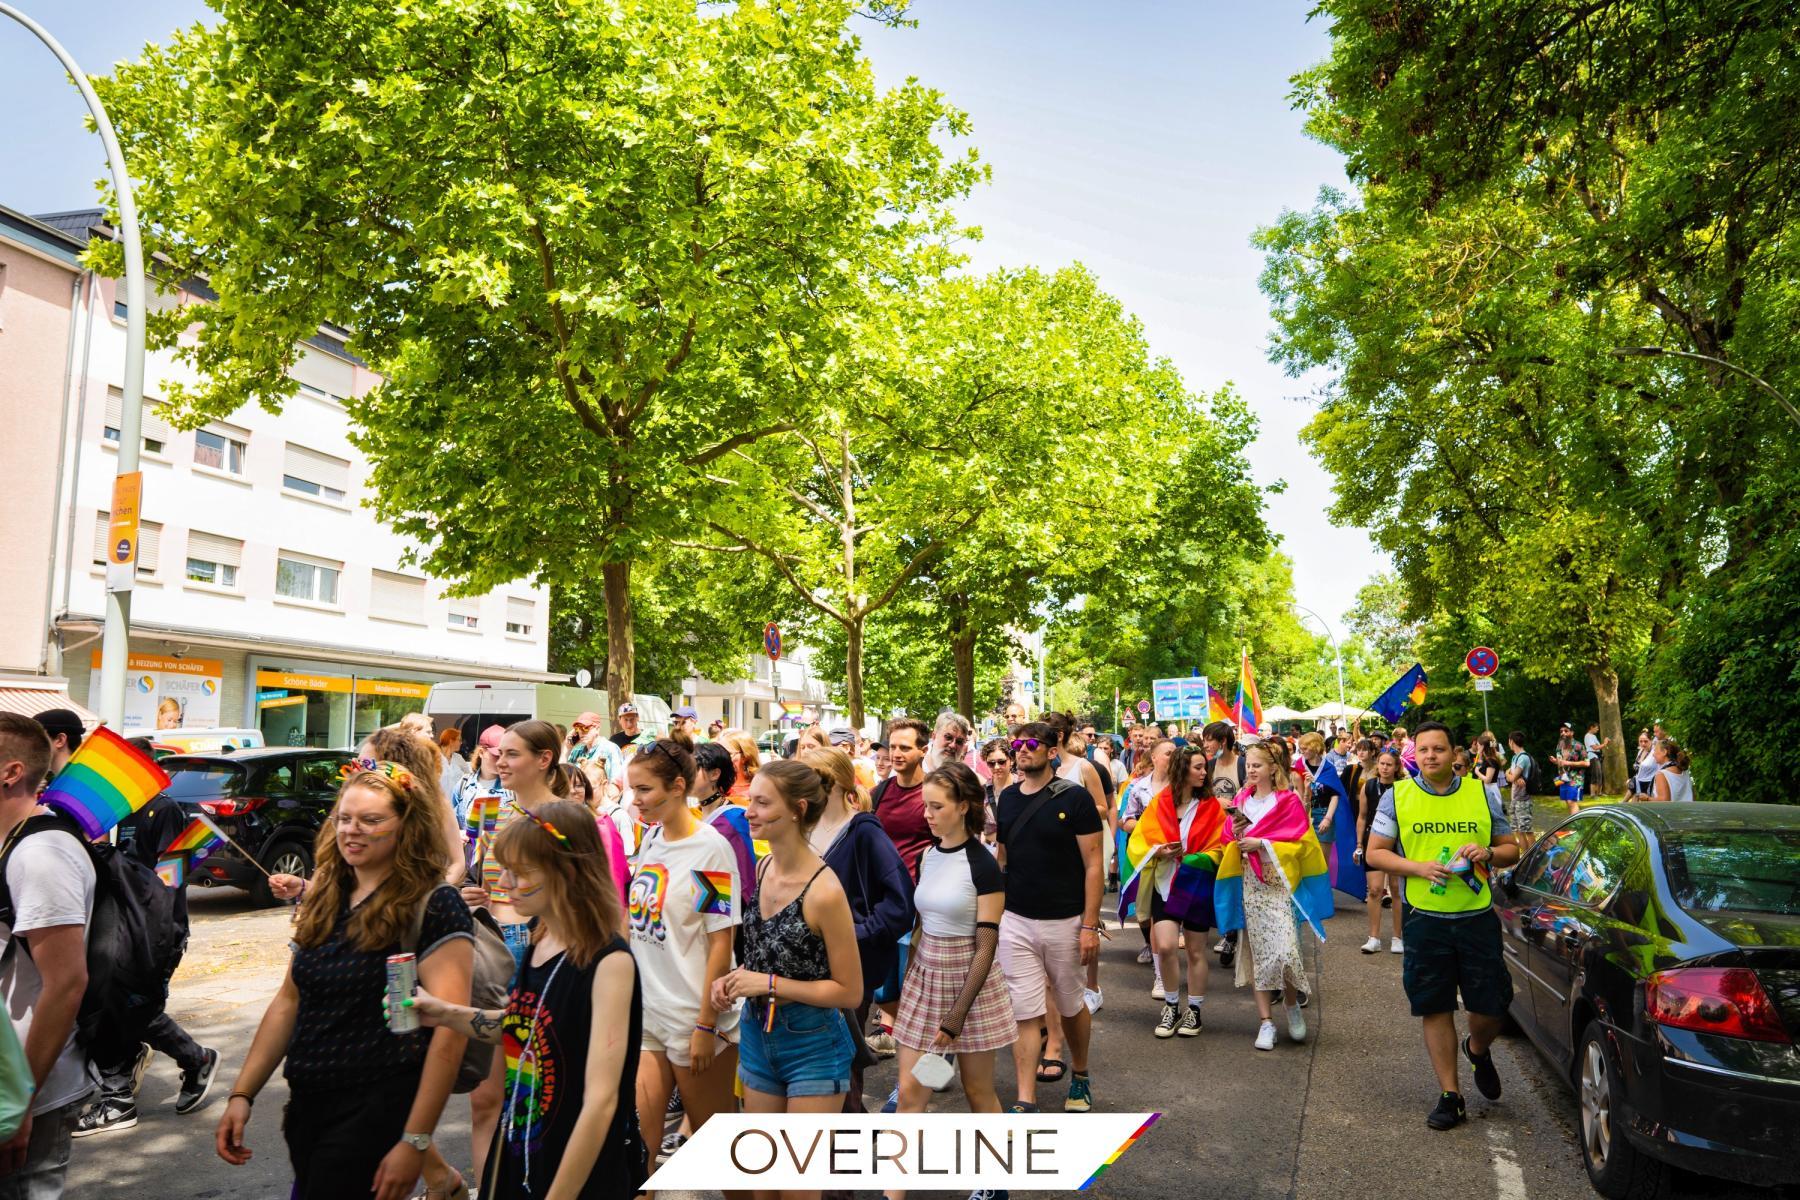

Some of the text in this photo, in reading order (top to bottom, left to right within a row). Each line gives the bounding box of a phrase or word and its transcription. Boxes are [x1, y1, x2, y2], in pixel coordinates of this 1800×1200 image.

[136, 659, 162, 669] HEIZUNG
[164, 662, 177, 670] VON
[178, 663, 205, 672] SCHÄFER
[283, 676, 329, 689] Schöne Bäder
[1412, 821, 1479, 834] ORDNER
